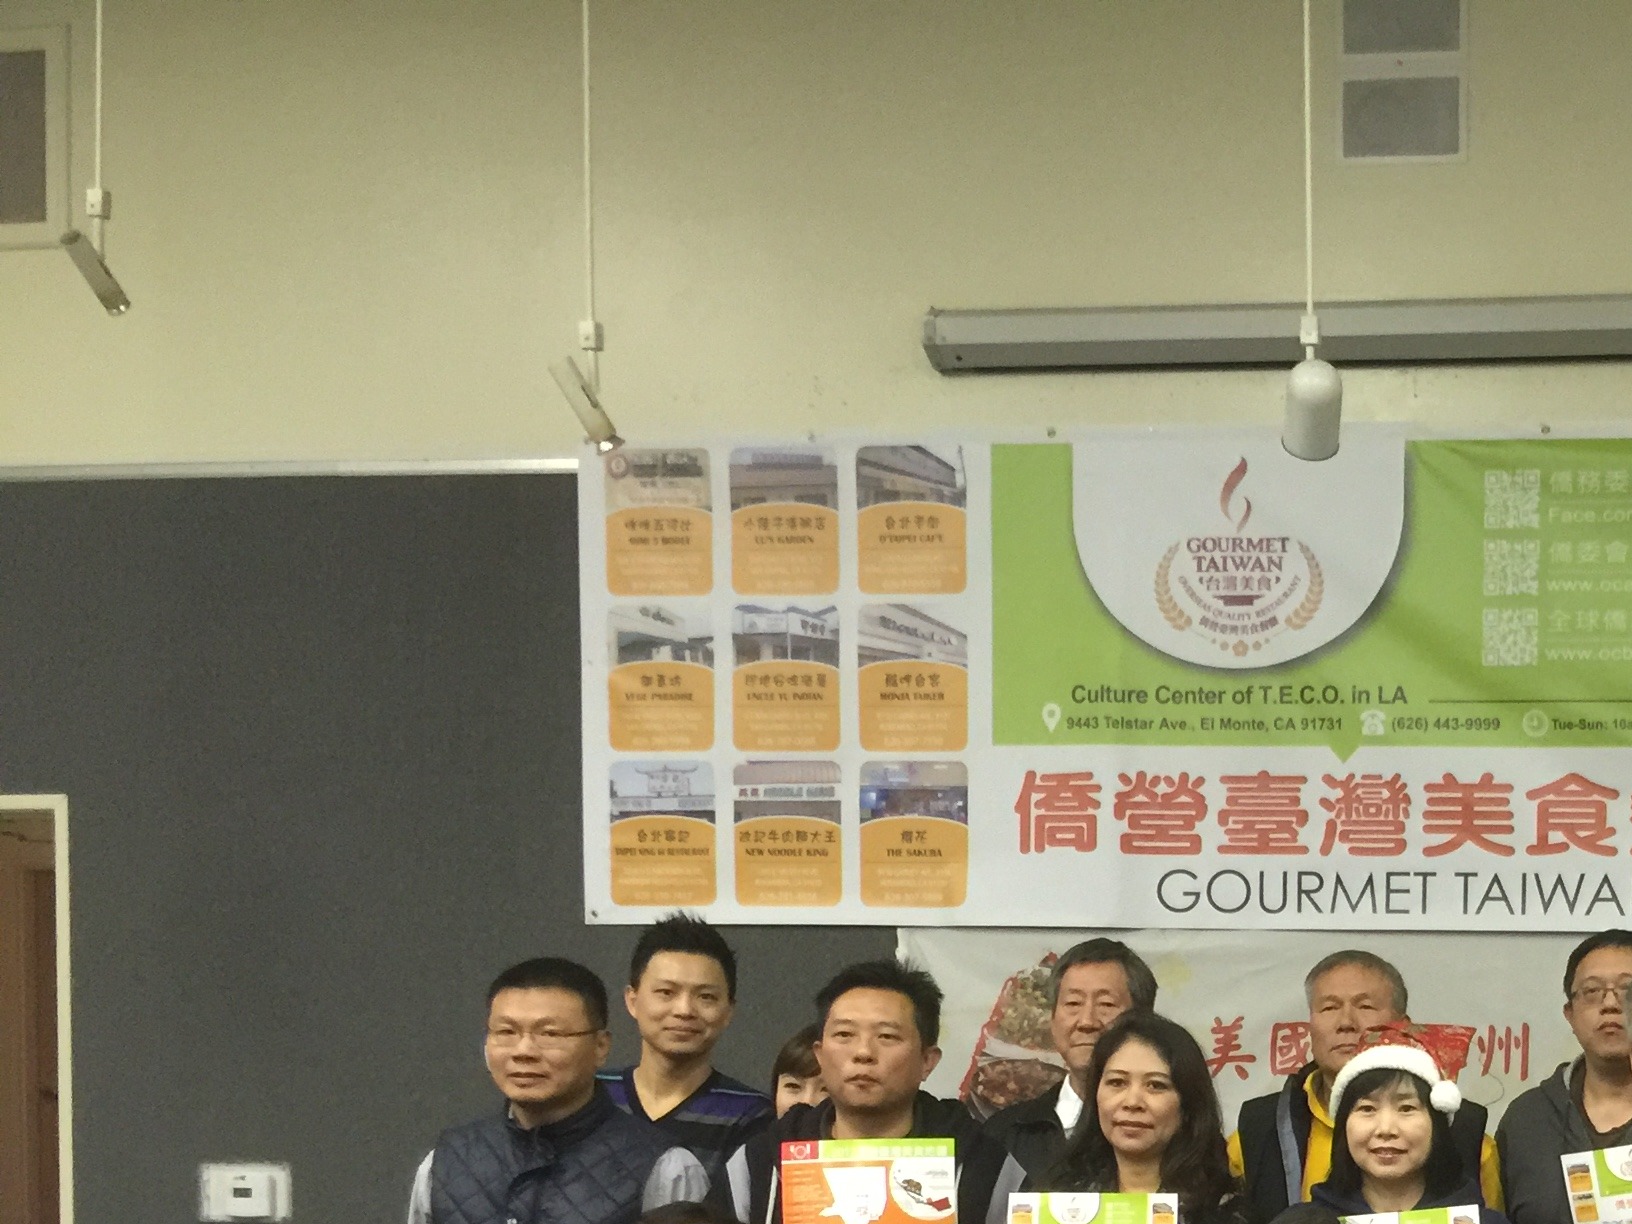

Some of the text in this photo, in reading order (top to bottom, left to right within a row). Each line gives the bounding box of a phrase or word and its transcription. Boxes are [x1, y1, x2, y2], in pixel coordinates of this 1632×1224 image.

[1187, 537, 1290, 553] GOURMET
[1193, 556, 1283, 572] TAIWAN
[1071, 685, 1408, 705] Culture Center of T.E.C.O. in LA
[1066, 717, 1099, 730] 9443
[1104, 717, 1154, 731] Telstar
[1200, 718, 1215, 731] El
[1220, 718, 1268, 732] Monte,
[1274, 718, 1295, 731] CA
[1301, 718, 1342, 731] 91731
[1392, 717, 1500, 733] (626) 443-9999
[1552, 718, 1607, 731] Tue-Sun:
[745, 848, 828, 857] NEW NOODLE KING
[886, 849, 902, 857] THE
[1157, 869, 1437, 914] GOURMET
